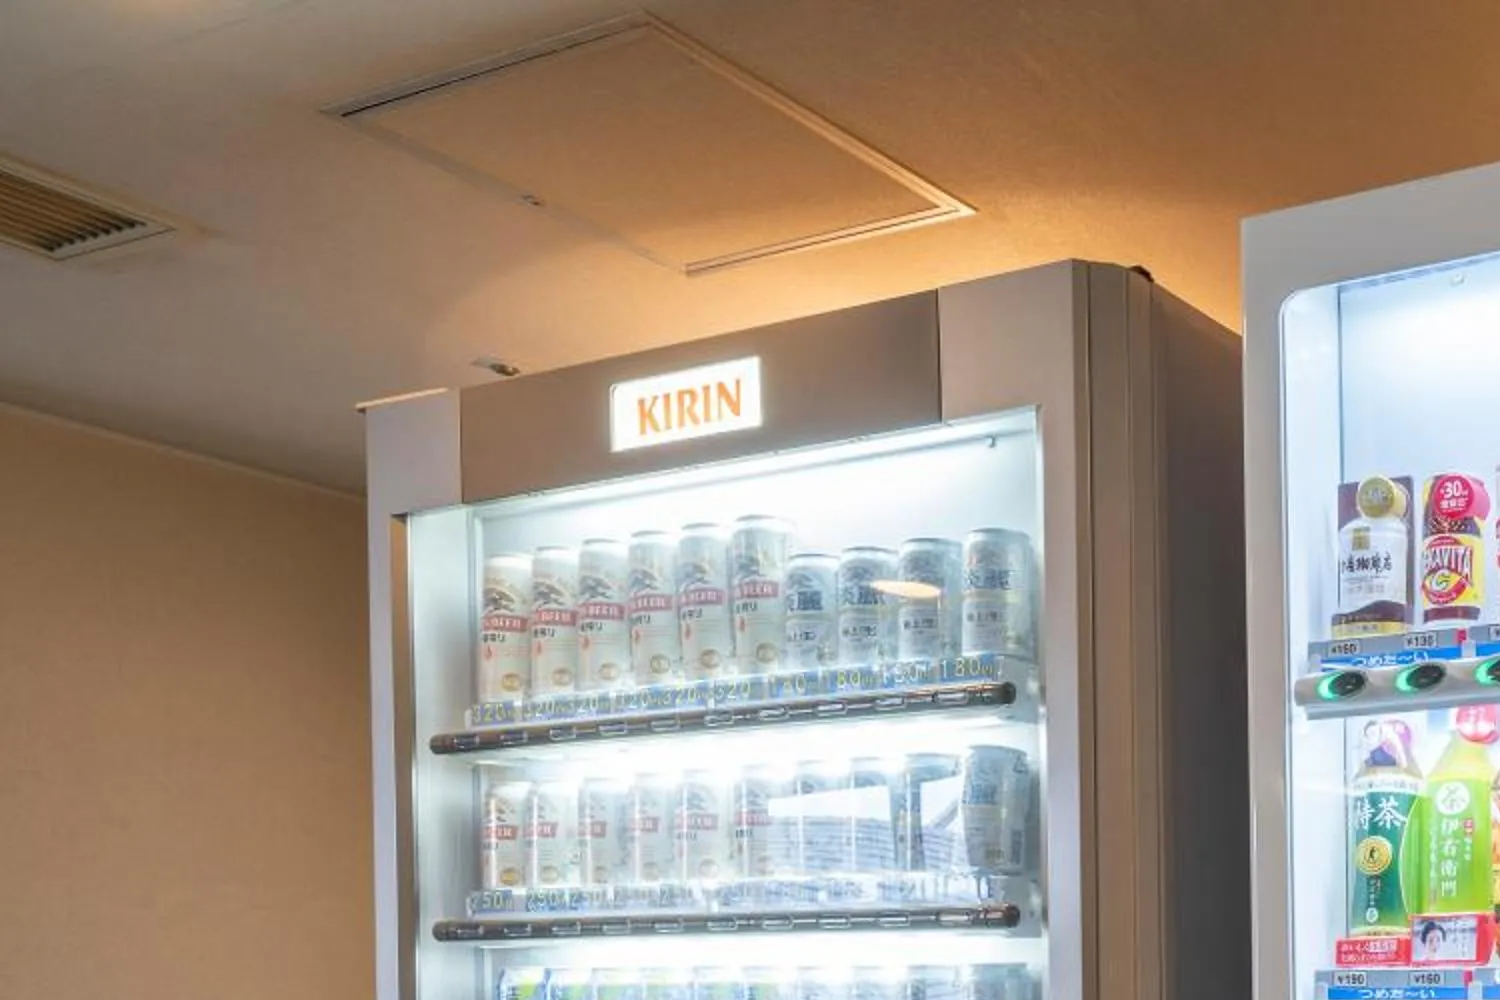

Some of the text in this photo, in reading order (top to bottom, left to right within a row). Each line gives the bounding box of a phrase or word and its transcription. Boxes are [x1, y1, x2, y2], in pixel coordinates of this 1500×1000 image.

[637, 377, 741, 436] KIRIN
[1441, 817, 1458, 897] 伊右衛門
